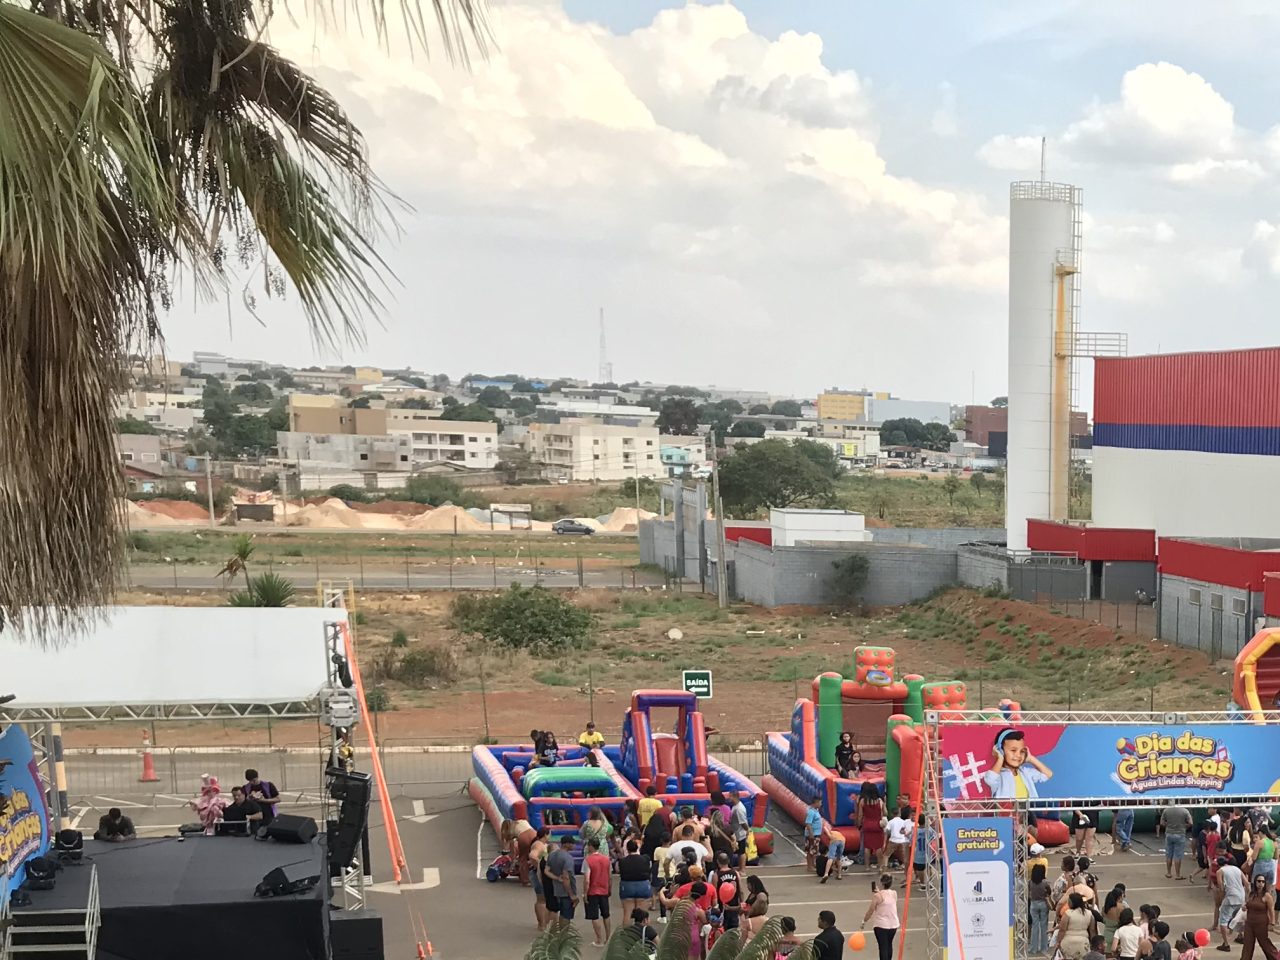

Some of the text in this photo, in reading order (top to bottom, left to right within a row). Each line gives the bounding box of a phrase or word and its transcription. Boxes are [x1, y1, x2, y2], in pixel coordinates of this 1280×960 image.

[686, 678, 708, 686] SAÍDA
[1135, 731, 1214, 755] Dia das
[1118, 753, 1232, 780] Crianças
[1159, 776, 1185, 786] Lindas
[1186, 775, 1223, 788] Shopping
[958, 828, 997, 838] Entrada
[956, 839, 999, 852] gratuita!
